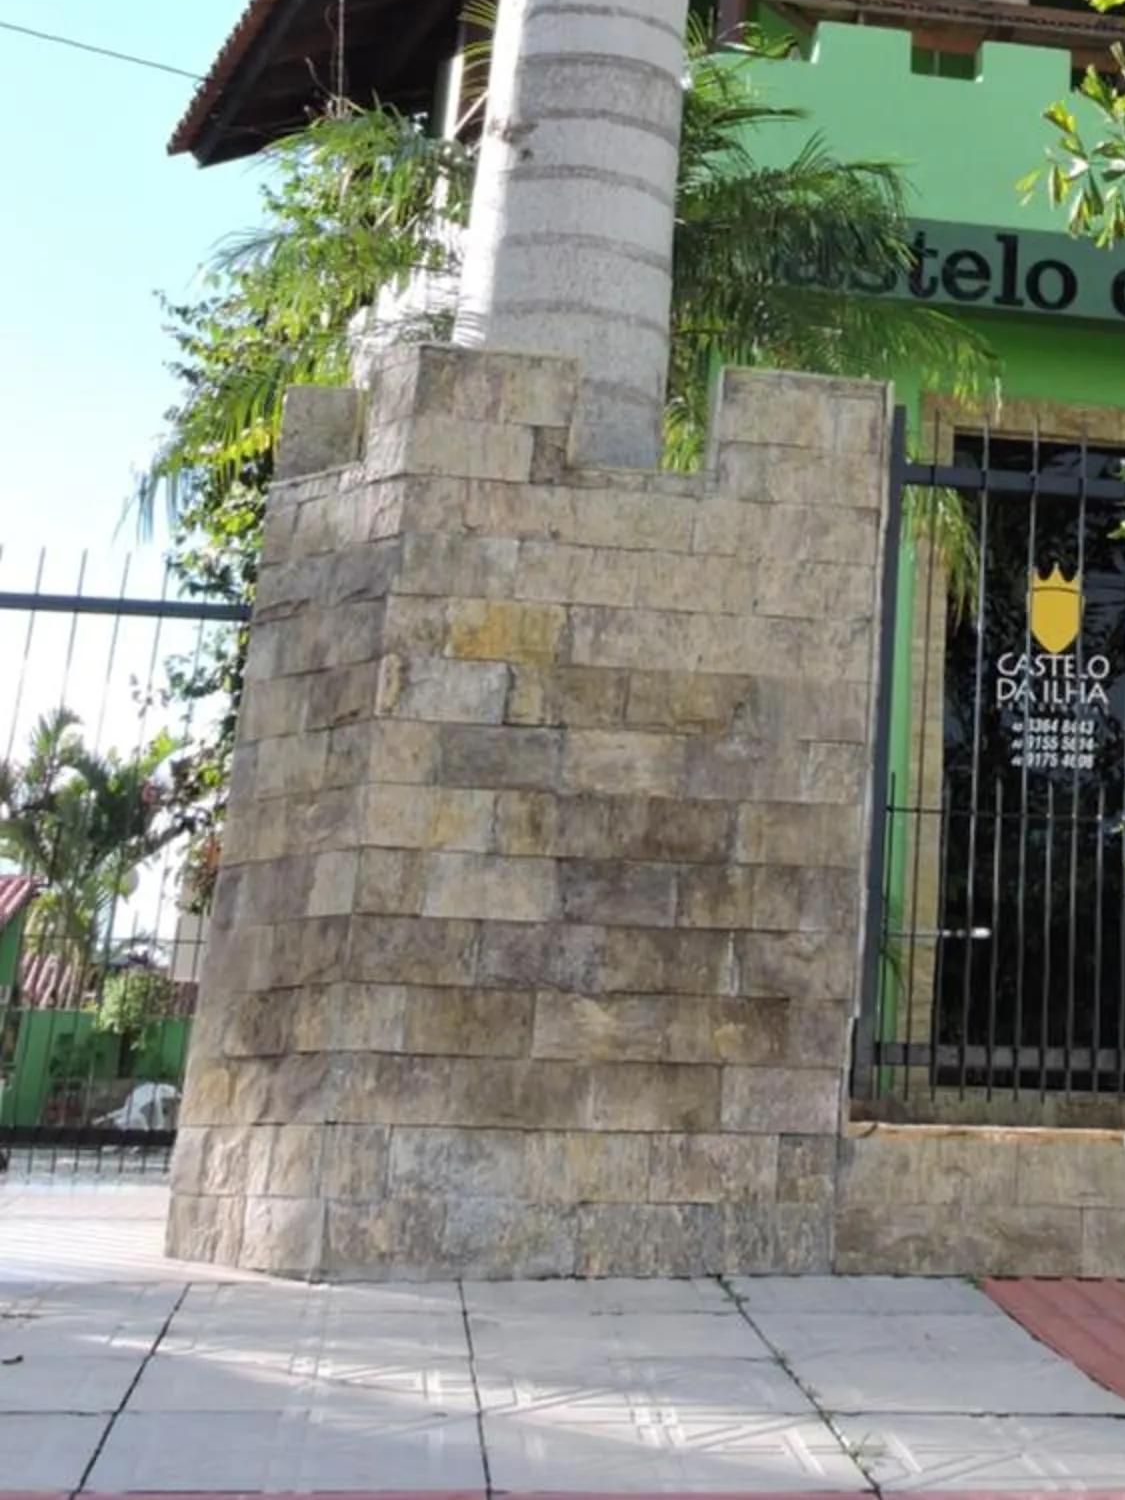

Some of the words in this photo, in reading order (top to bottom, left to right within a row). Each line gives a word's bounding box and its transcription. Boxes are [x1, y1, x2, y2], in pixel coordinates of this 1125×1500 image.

[778, 231, 1079, 312] astelo
[997, 679, 1036, 702] DA
[1043, 680, 1109, 704] ILHA
